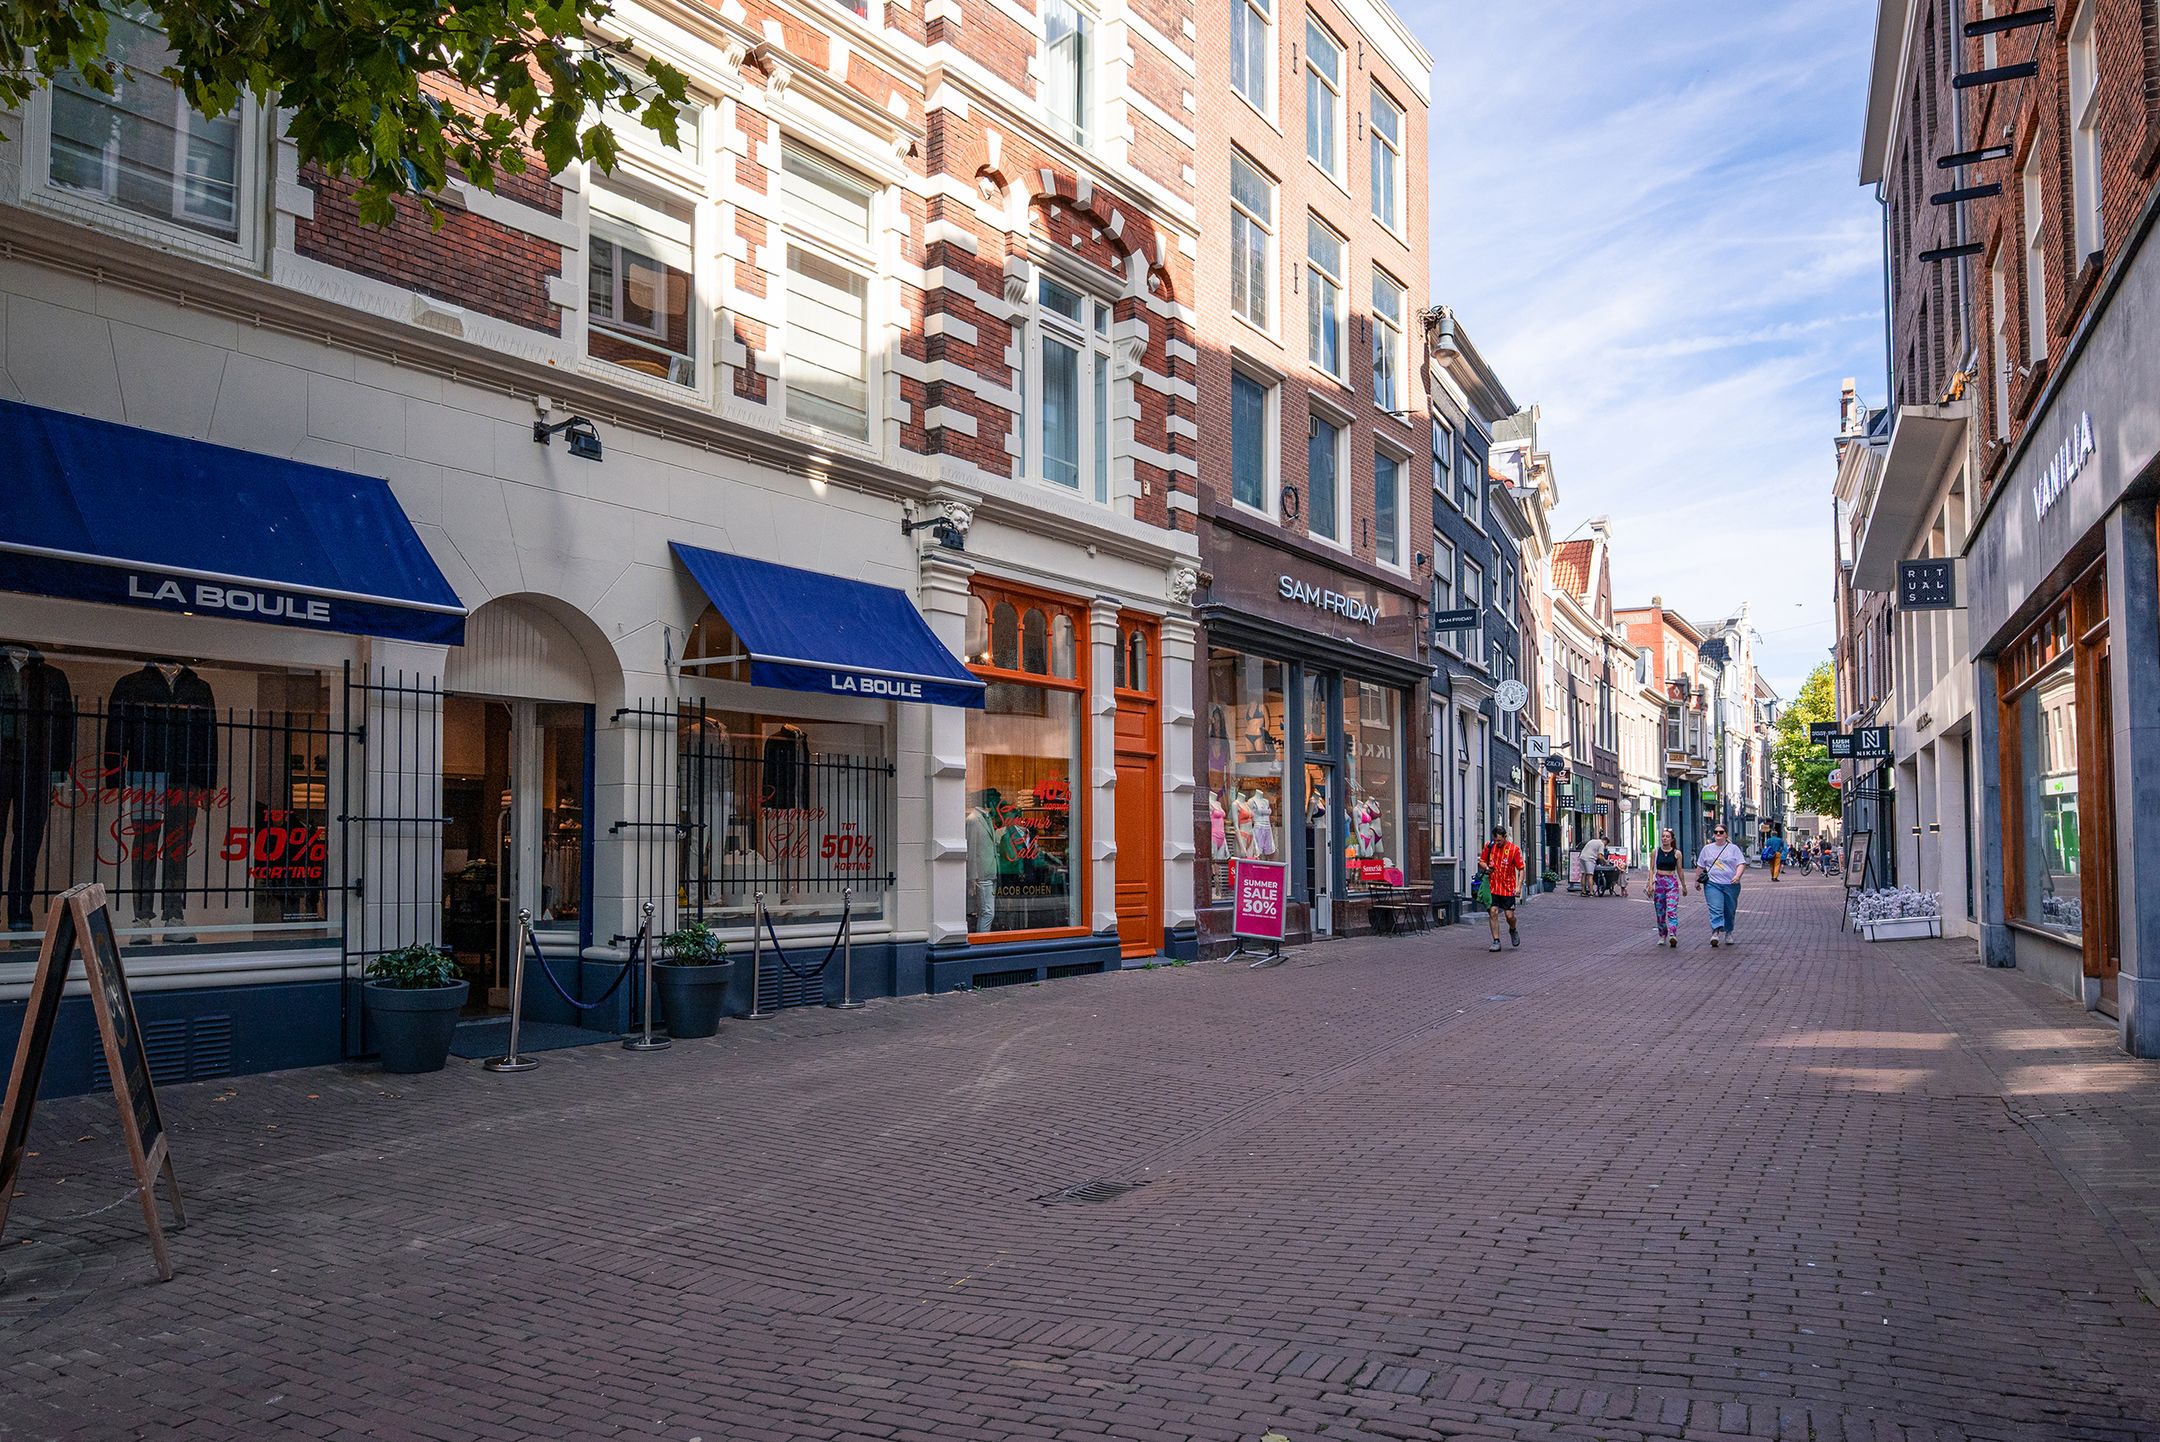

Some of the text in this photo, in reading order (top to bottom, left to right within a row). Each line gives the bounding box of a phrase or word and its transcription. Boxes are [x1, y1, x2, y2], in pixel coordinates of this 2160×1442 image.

[2032, 411, 2095, 522] VANILIA
[129, 575, 331, 622] LA BOULE
[1279, 575, 1380, 626] SAM FRIDAY
[831, 674, 922, 697] LA BOULE
[1033, 779, 1072, 801] 40%
[993, 799, 1051, 829] Summer
[219, 826, 326, 861] 50%
[762, 823, 809, 862] Sale
[821, 834, 874, 859] 50%
[1007, 830, 1040, 862] Sale
[248, 866, 322, 879] KORTING
[834, 862, 871, 871] KORTING
[1243, 879, 1278, 889] SUMMER
[1243, 887, 1278, 901] SALE
[1242, 898, 1277, 916] 30%
